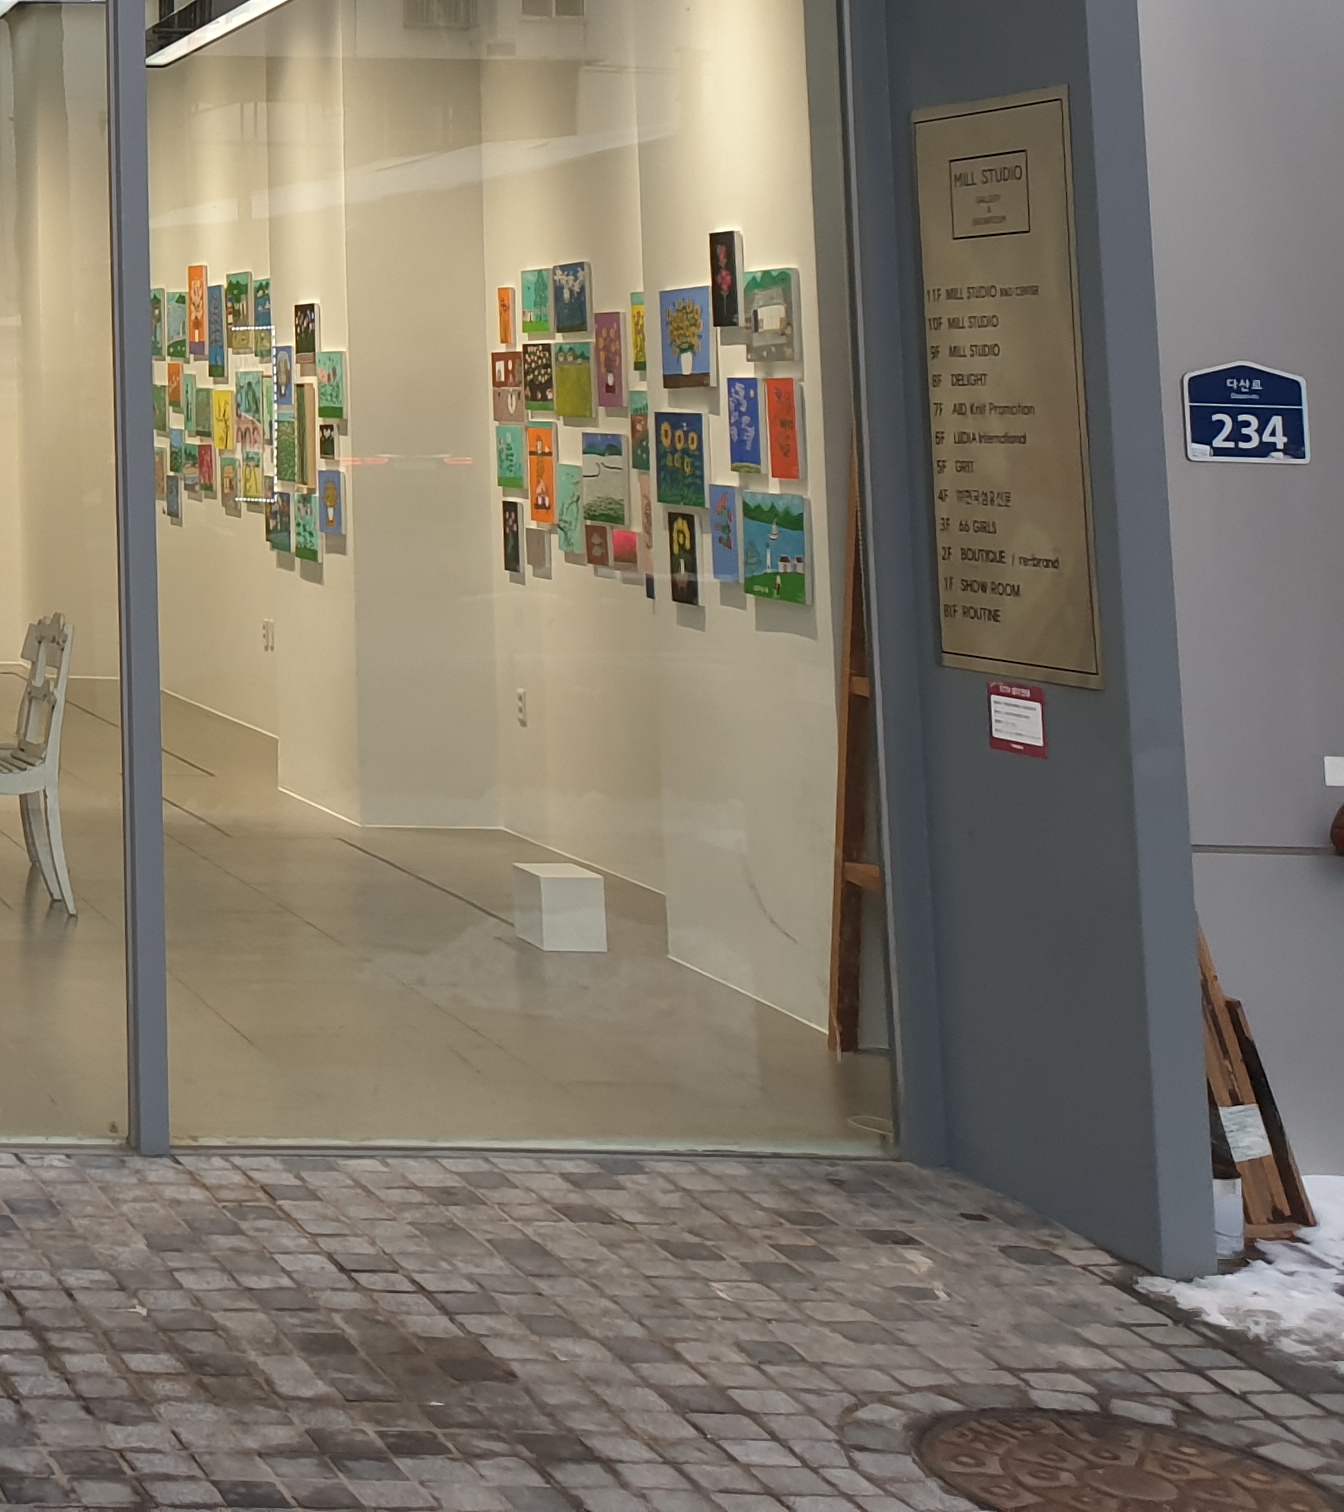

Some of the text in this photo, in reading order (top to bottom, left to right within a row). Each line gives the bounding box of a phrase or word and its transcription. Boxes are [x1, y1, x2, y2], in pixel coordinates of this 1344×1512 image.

[954, 164, 1023, 187] MILL STUDIO
[966, 285, 998, 300] STUDIO
[947, 316, 966, 330] MILL
[968, 314, 1000, 329] STUDIO
[949, 344, 968, 358] MILL
[969, 343, 1001, 358] STUDIO
[950, 372, 989, 387] DELIGHT
[933, 403, 944, 416] 7F
[1211, 413, 1288, 450] 234
[938, 488, 949, 503] 4F
[941, 546, 953, 561] 2F
[960, 547, 1007, 565] BOUTIQUE
[960, 578, 988, 594] SHOW
[990, 581, 1021, 598] ROOM
[962, 604, 1002, 623] ROUTINE
